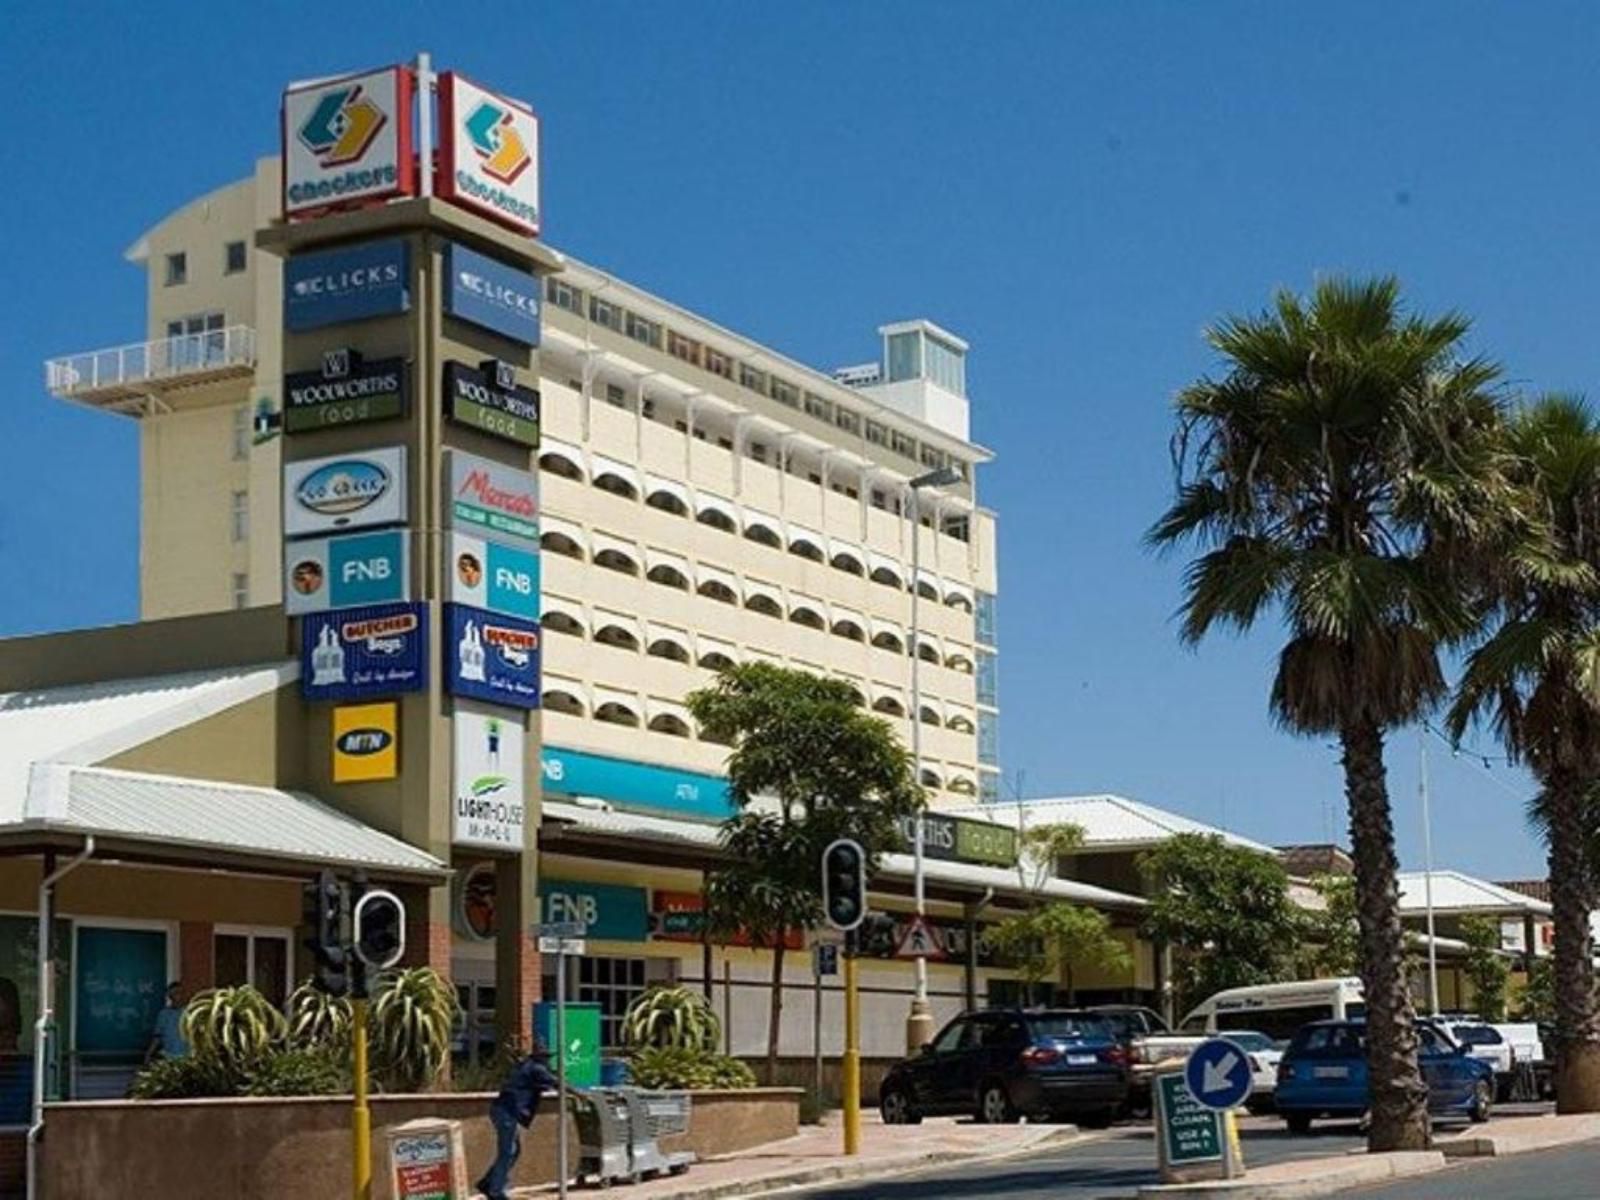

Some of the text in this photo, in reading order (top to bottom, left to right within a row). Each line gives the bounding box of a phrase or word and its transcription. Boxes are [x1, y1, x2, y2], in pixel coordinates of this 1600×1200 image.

[312, 265, 398, 293] CLICKS
[470, 277, 537, 315] CLICKS
[291, 374, 398, 404] WOOLWORTHS
[343, 558, 391, 583] FNB
[496, 568, 531, 594] FNB
[346, 616, 412, 637] BUTCHER
[345, 734, 383, 750] MTN
[458, 797, 522, 825] LIGHTHOUSE
[548, 893, 598, 924] FNB
